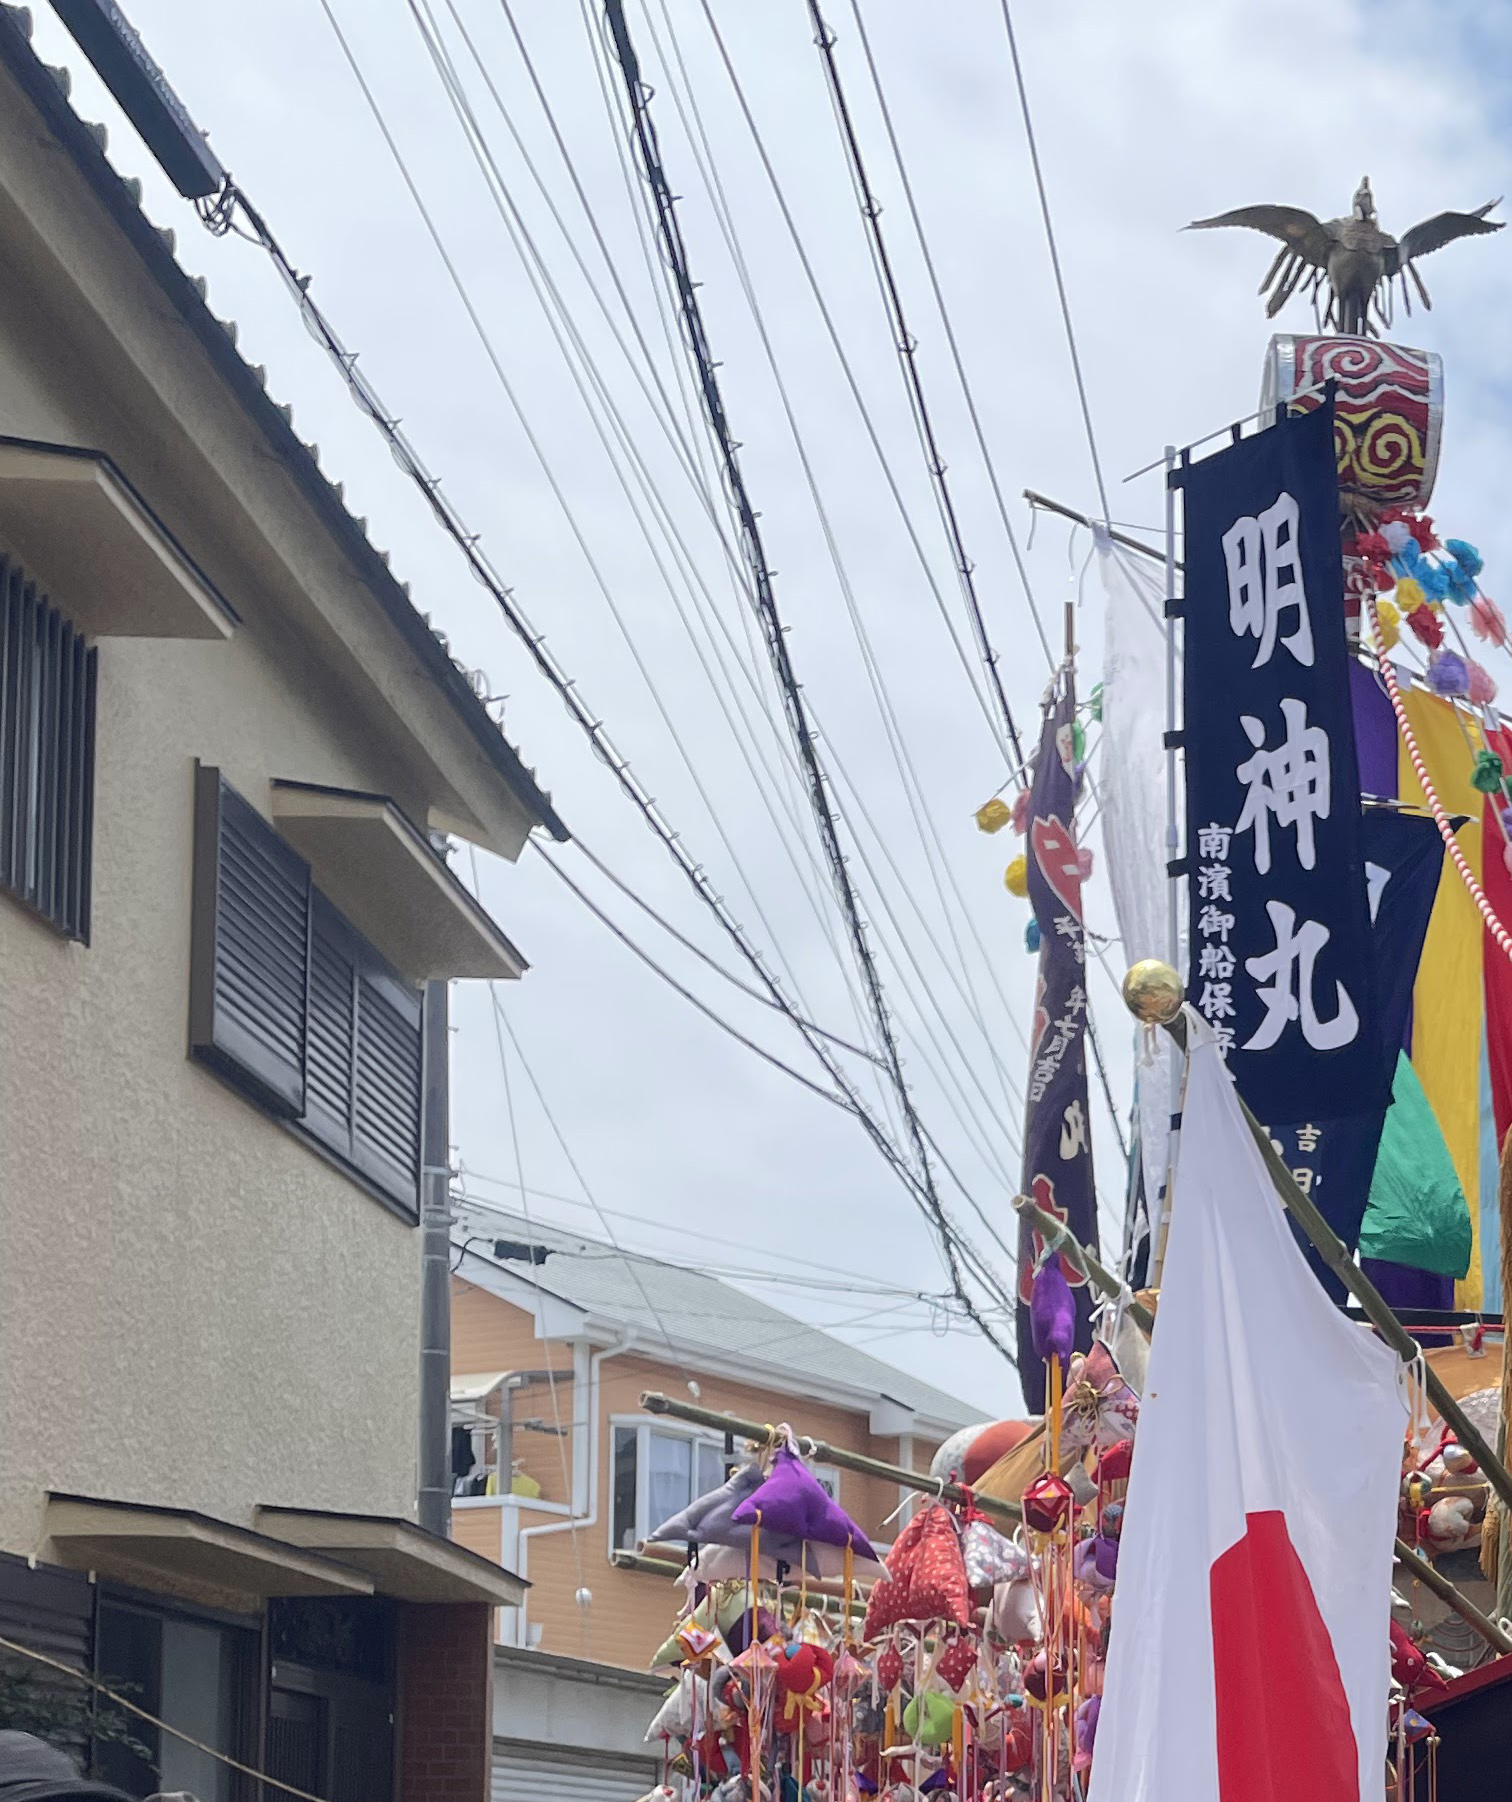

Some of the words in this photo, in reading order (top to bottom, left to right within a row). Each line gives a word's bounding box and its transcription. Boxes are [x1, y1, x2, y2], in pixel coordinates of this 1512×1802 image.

[1222, 491, 1361, 1051] 明神丸
[1196, 822, 1236, 1082] 南濱御船保存
[1293, 1123, 1322, 1194] 吉日
